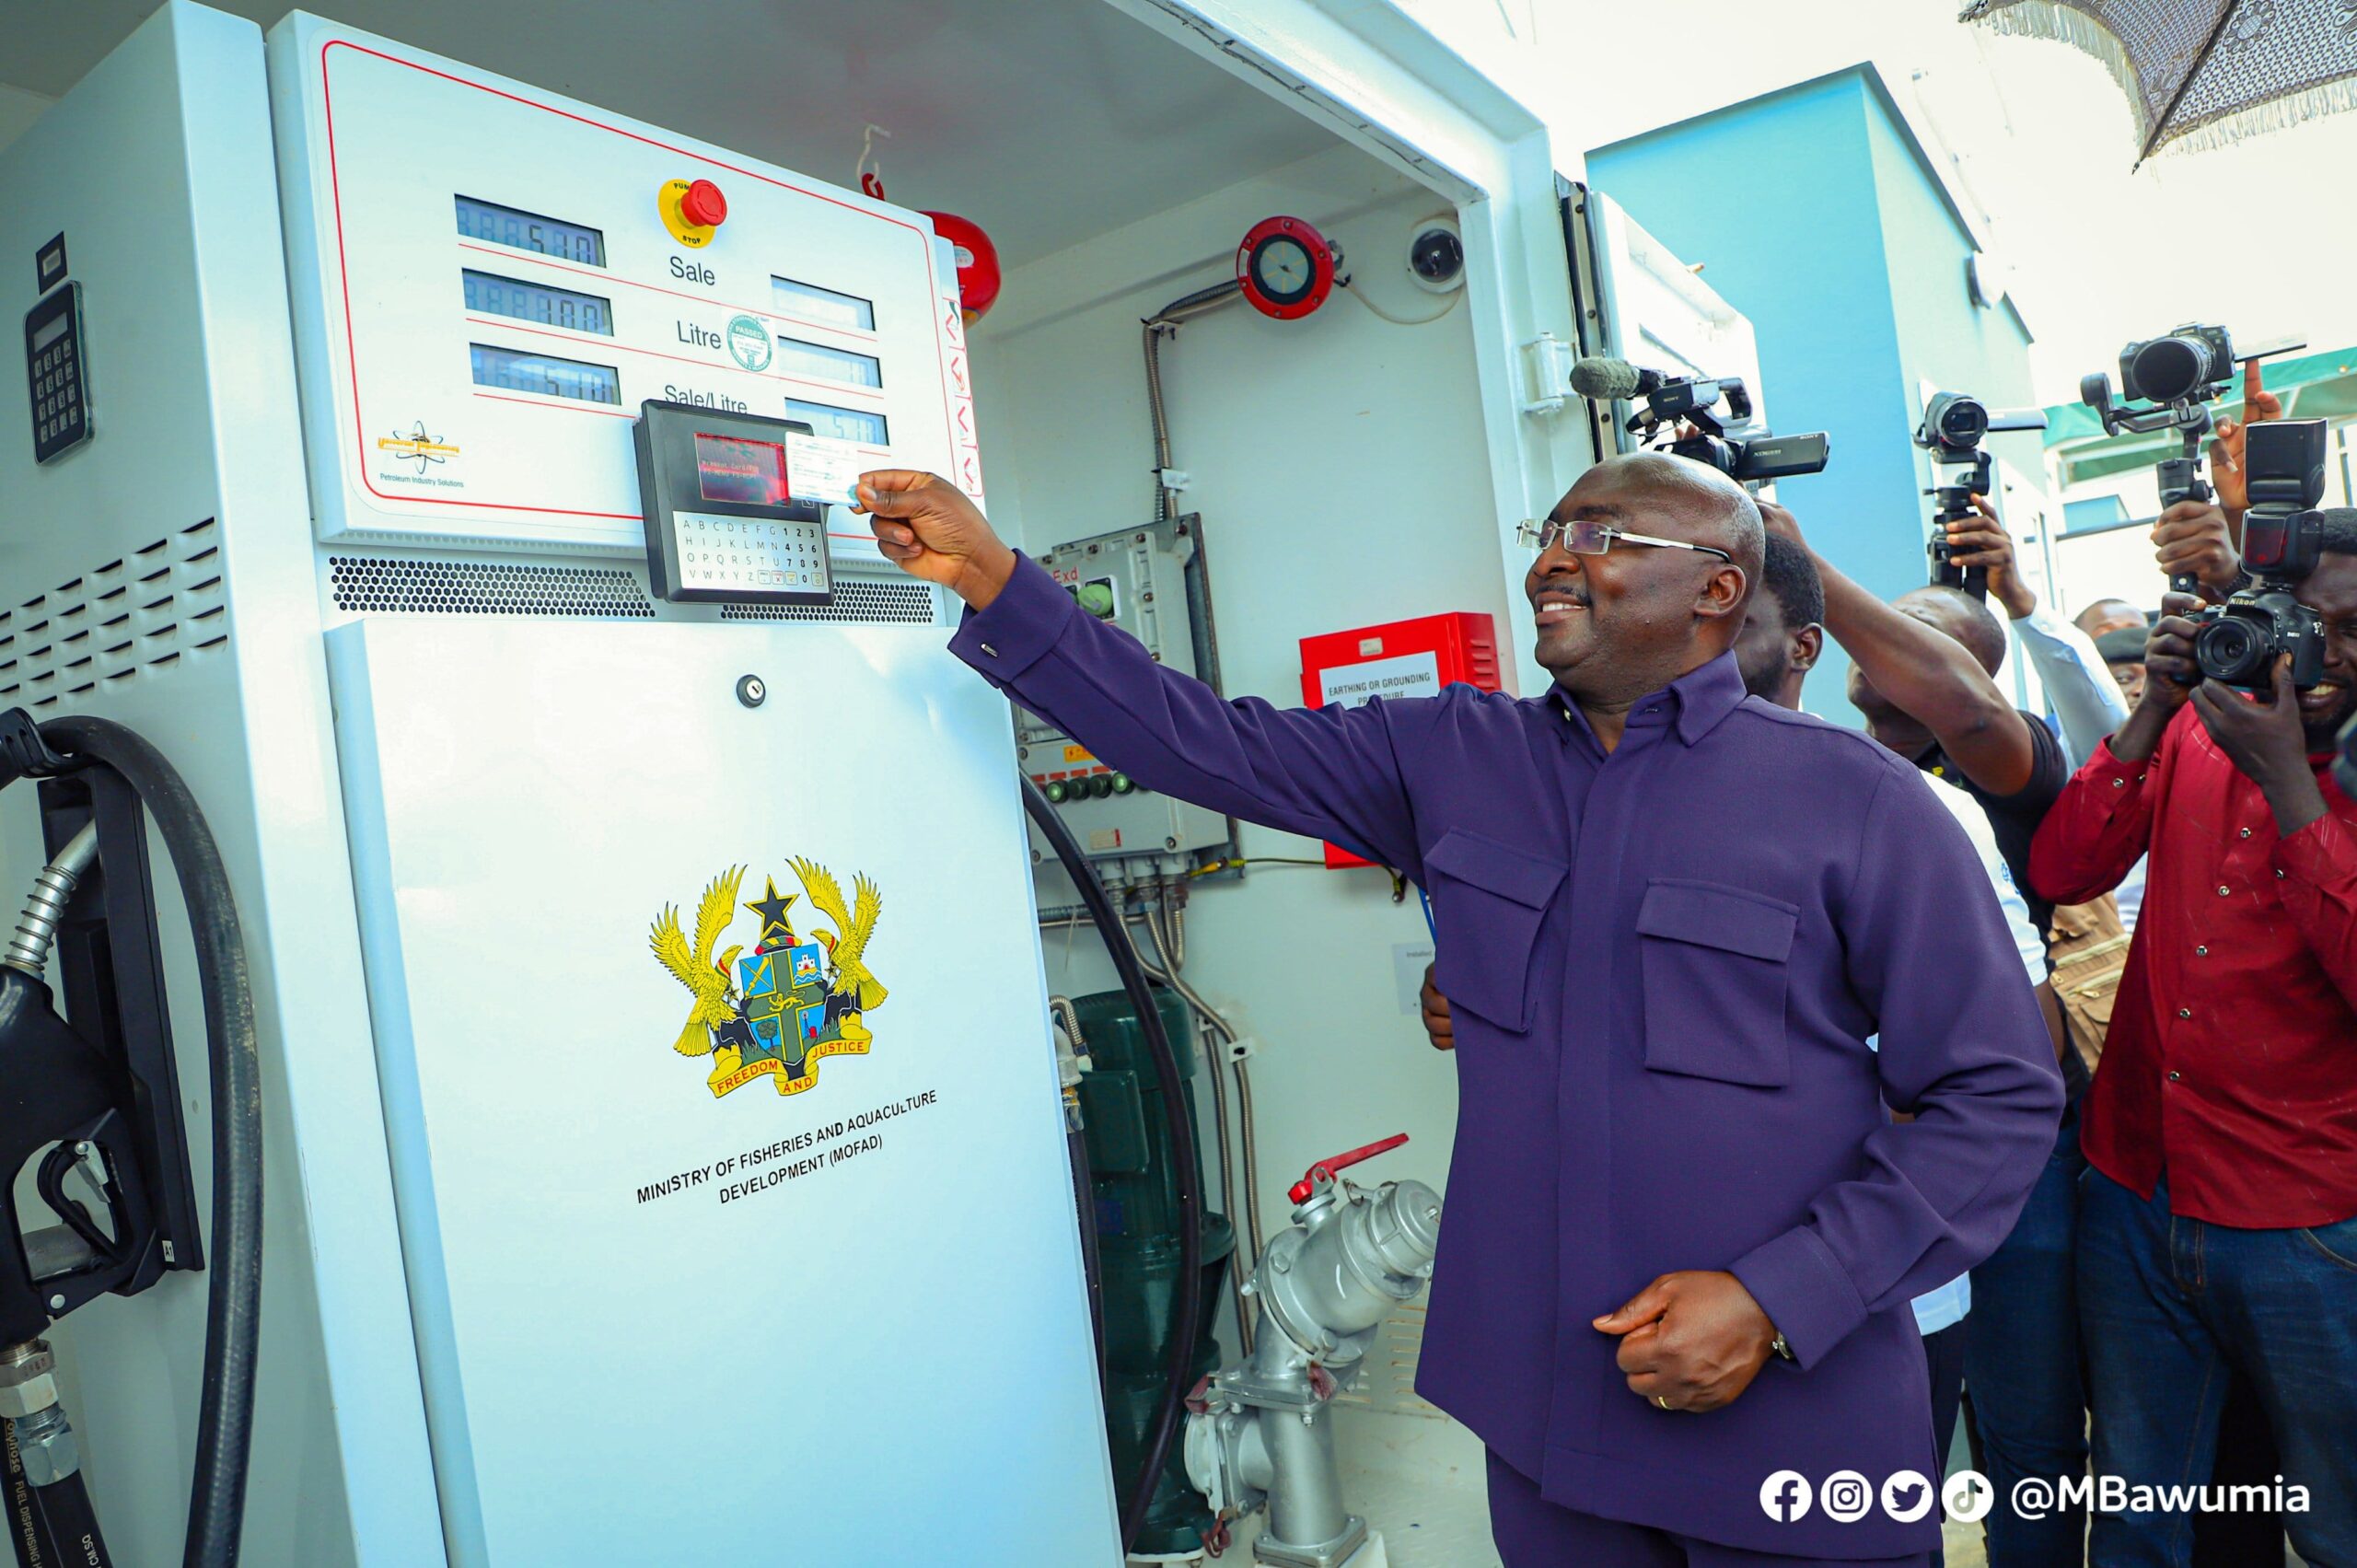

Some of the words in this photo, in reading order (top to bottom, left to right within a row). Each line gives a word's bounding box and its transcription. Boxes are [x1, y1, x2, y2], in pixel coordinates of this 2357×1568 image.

[673, 182, 690, 191] PUM
[682, 235, 701, 244] STOP
[669, 255, 715, 286] Sale
[677, 320, 722, 350] Litre
[665, 385, 748, 414] Sale/Litre
[380, 472, 411, 483] Petroleum
[412, 476, 435, 486] Industry
[437, 479, 464, 488] Solutions
[683, 520, 691, 528] A
[699, 520, 705, 530] B
[714, 521, 720, 531] C
[727, 523, 734, 531] D
[742, 524, 749, 533] E
[757, 525, 761, 533] F
[770, 526, 775, 535] G
[784, 528, 788, 536] 1
[796, 528, 802, 537] 2
[809, 528, 814, 538] 3
[686, 536, 692, 545] H
[716, 539, 721, 547] J
[730, 540, 736, 548] K
[744, 540, 749, 549] L
[757, 541, 765, 550] M
[772, 542, 778, 551] N
[785, 543, 790, 552] 4
[798, 544, 803, 552] 5
[811, 544, 816, 552] 6
[702, 553, 709, 563] P
[716, 554, 724, 565] Q
[732, 555, 737, 564] R
[747, 556, 751, 565] S
[773, 557, 779, 566] U
[787, 558, 792, 567] 7
[800, 559, 805, 567] 8
[813, 560, 818, 568] 9
[690, 570, 696, 578] V
[703, 570, 712, 579] W
[720, 571, 726, 579] X
[733, 572, 738, 580] Y
[749, 572, 754, 581] Z
[1052, 567, 1078, 583] Exd
[2230, 598, 2256, 606] Nikon
[1329, 682, 1367, 697] EARTHING
[1369, 680, 1380, 691] OR
[1382, 672, 1430, 689] GROUNDING
[716, 1060, 778, 1094] FREEDOM
[784, 1077, 812, 1093] AND
[812, 1041, 865, 1058] JUSTICE
[637, 1166, 711, 1203] MINISTRY
[715, 1158, 736, 1177] OF
[739, 1132, 813, 1169] FISHERIES
[817, 1122, 843, 1143] AND
[847, 1089, 937, 1132] AQUACULTURE
[719, 1154, 825, 1204] DEVELOPMENT
[830, 1133, 883, 1167] (MOFAD)
[16, 1481, 27, 1506] FUEL
[20, 1506, 41, 1563] DISPENSING
